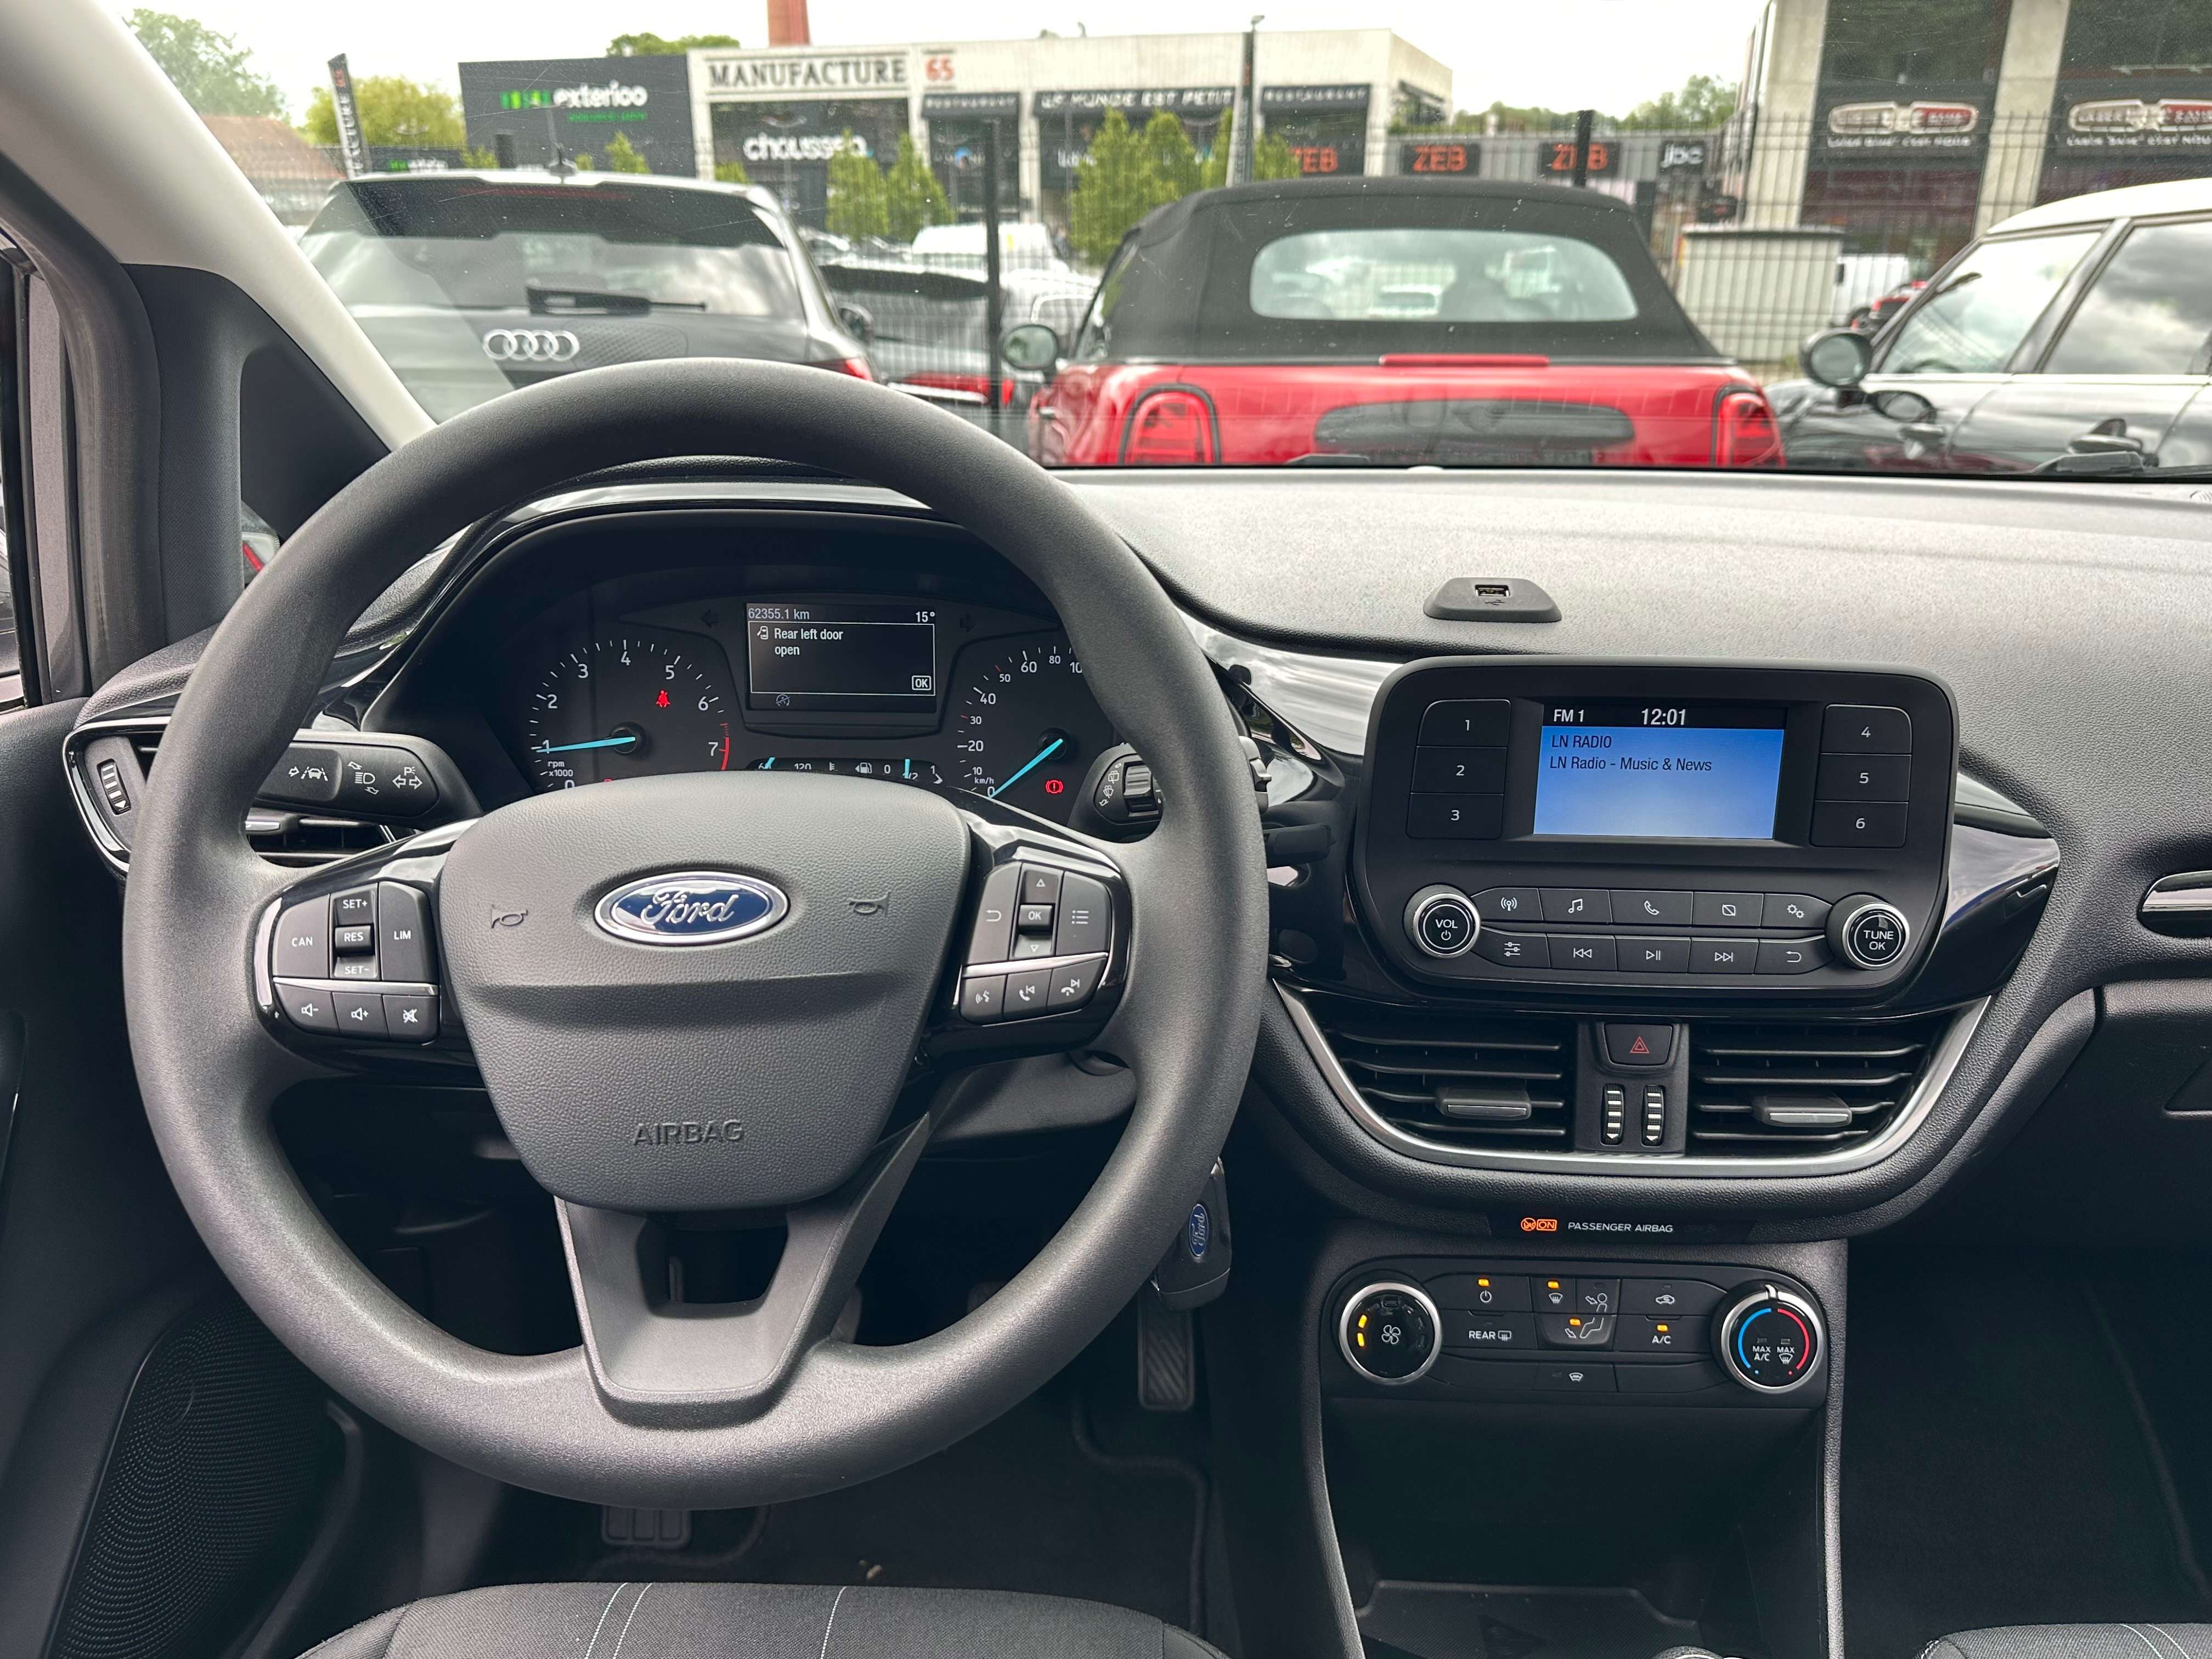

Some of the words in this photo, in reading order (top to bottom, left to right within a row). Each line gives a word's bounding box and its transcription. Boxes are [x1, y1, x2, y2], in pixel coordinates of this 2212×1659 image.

[709, 58, 907, 88] MANUFACTURE
[925, 58, 955, 82] 65
[553, 79, 648, 108] exterioo
[1141, 90, 1178, 107] EST
[1413, 143, 1468, 172] ZEB
[748, 608, 789, 619] 62355.1
[794, 608, 810, 620] km
[774, 628, 799, 640] Rear
[800, 628, 817, 640] left
[820, 629, 843, 640] door
[775, 645, 800, 657] open
[620, 651, 631, 666] 4
[1048, 655, 1061, 664] 80
[578, 663, 589, 679] 3
[665, 665, 675, 680] 5
[1020, 661, 1037, 673] 60
[915, 678, 928, 689] OK
[999, 674, 1011, 682] 50
[548, 694, 558, 709] 2
[698, 696, 709, 711] 6
[980, 692, 996, 704] 40
[970, 716, 982, 725] 30
[1553, 709, 1574, 722] FM
[1578, 709, 1584, 722] 1
[1640, 708, 1686, 726] 12:01
[1465, 719, 1470, 731] 1
[1861, 726, 1871, 738] 4
[968, 740, 984, 752] 20
[1551, 735, 1569, 748] LN
[1572, 735, 1612, 749] RADIO
[708, 741, 719, 757] 7
[548, 760, 565, 769] rpm
[884, 764, 890, 774] 0
[1550, 756, 1567, 769] LN
[1571, 756, 1606, 770] Radio
[1620, 757, 1658, 771] Music
[1662, 758, 1672, 771] &
[1676, 758, 1712, 771] News
[549, 769, 573, 777] x1000
[930, 765, 935, 775] 1
[973, 767, 982, 775] 10
[1455, 765, 1465, 776] 2
[974, 776, 994, 785] km/h
[1859, 772, 1869, 784] 5
[1451, 810, 1460, 821] 3
[1855, 817, 1866, 829] 6
[640, 887, 739, 926] Ford
[1028, 911, 1041, 921] OK
[1435, 919, 1458, 929] VOL
[343, 932, 364, 942] RES
[393, 930, 411, 940] LIM
[1863, 930, 1894, 940] TUNE
[291, 936, 313, 947] CAN
[1869, 941, 1886, 951] OK
[633, 1119, 743, 1145] AIRBAG
[1191, 1212, 1206, 1246] Ford
[1538, 1221, 1556, 1229] ON
[1567, 1222, 1631, 1232] PASSENGER
[1634, 1224, 1673, 1233] AIRBAG
[1469, 1330, 1496, 1340] REAR
[1651, 1335, 1671, 1345] A/C
[1754, 1353, 1770, 1362] A/C
